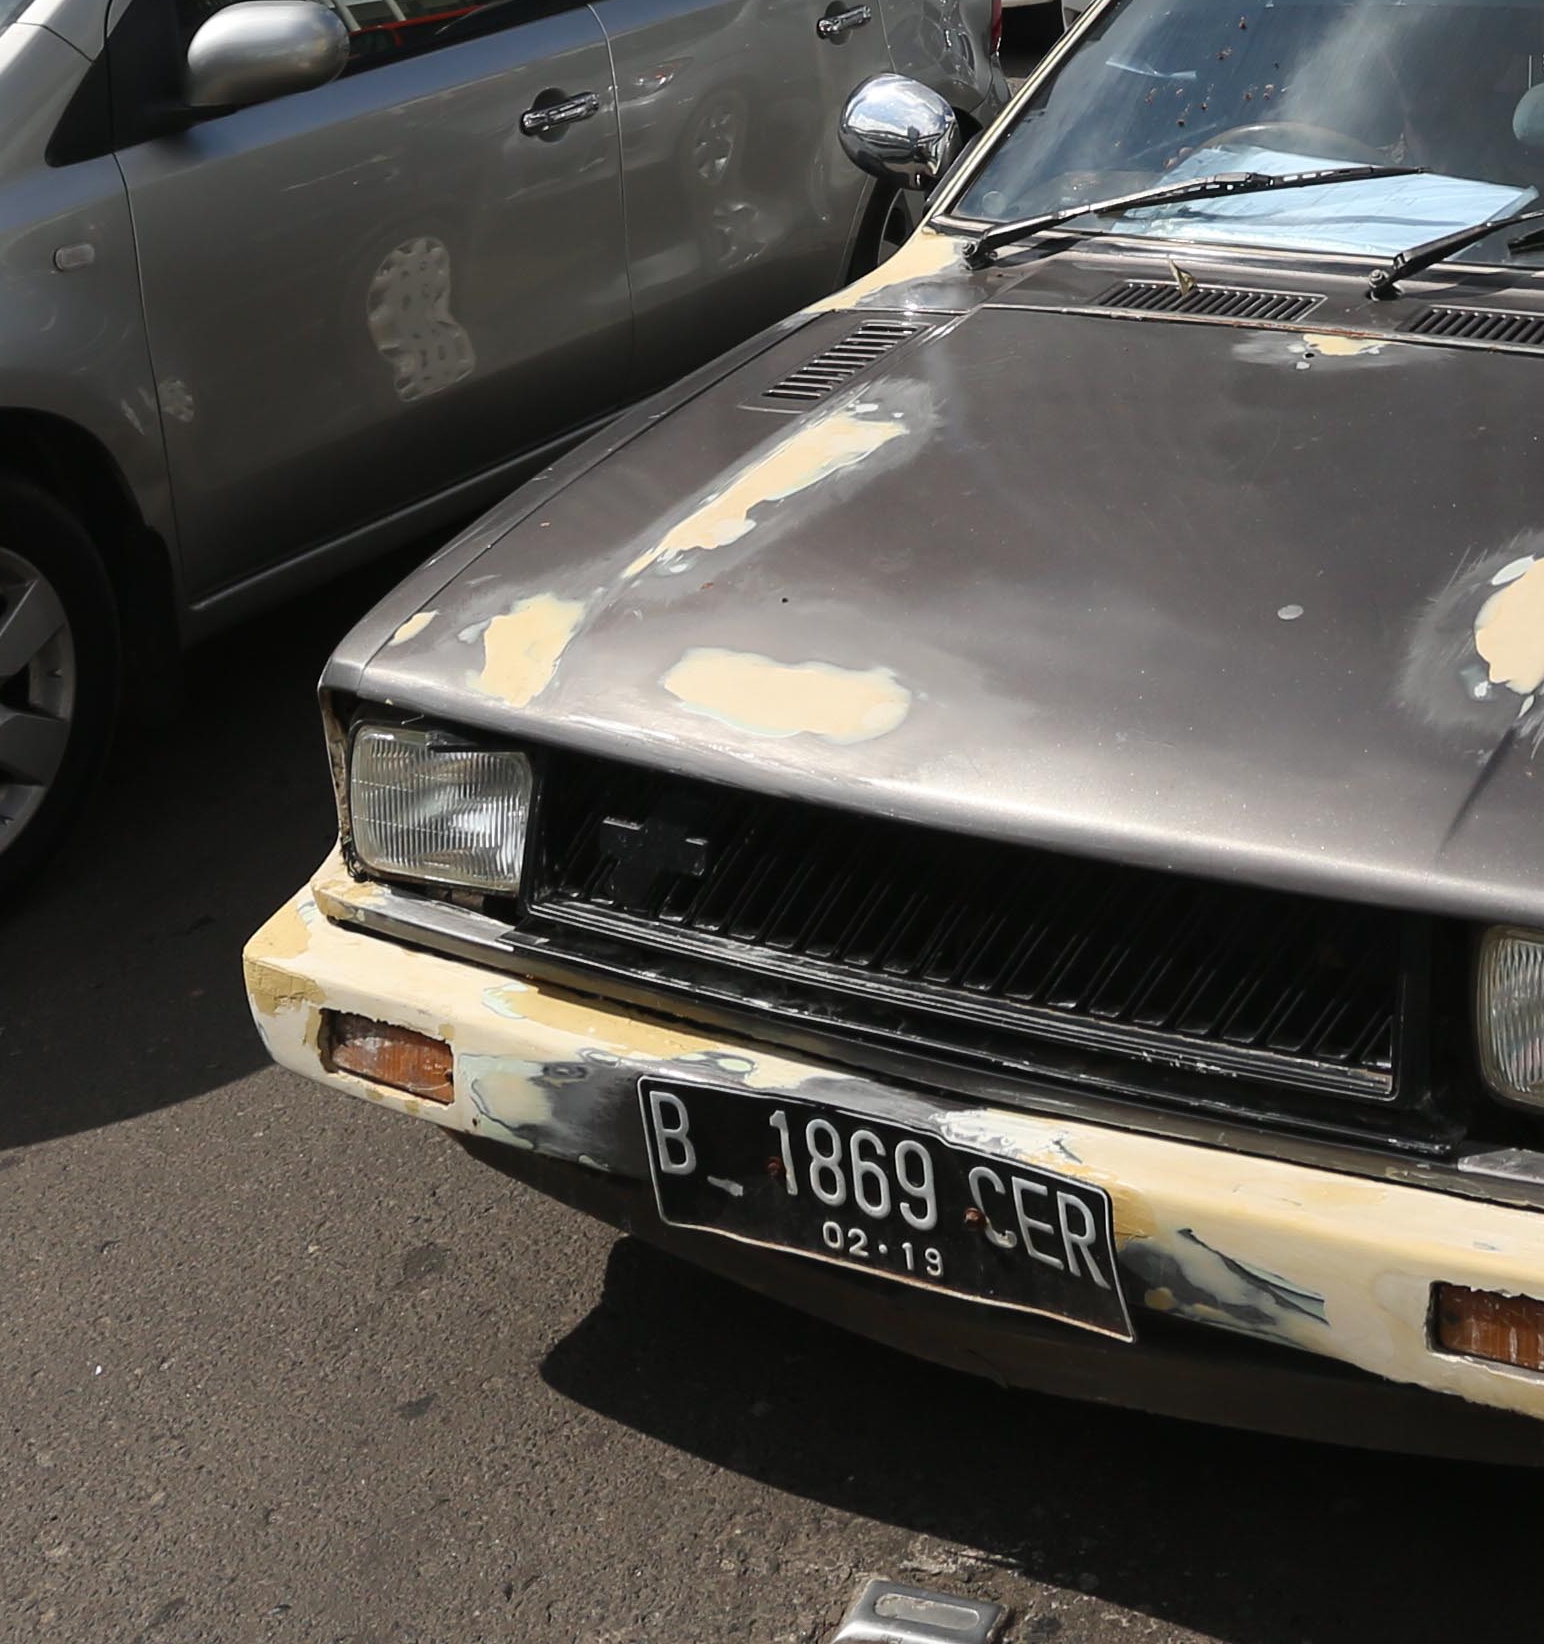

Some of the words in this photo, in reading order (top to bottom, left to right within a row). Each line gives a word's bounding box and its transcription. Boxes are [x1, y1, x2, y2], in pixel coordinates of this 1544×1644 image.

[649, 1090, 697, 1176] B
[768, 1109, 939, 1231] 1869
[968, 1166, 1112, 1291] CER
